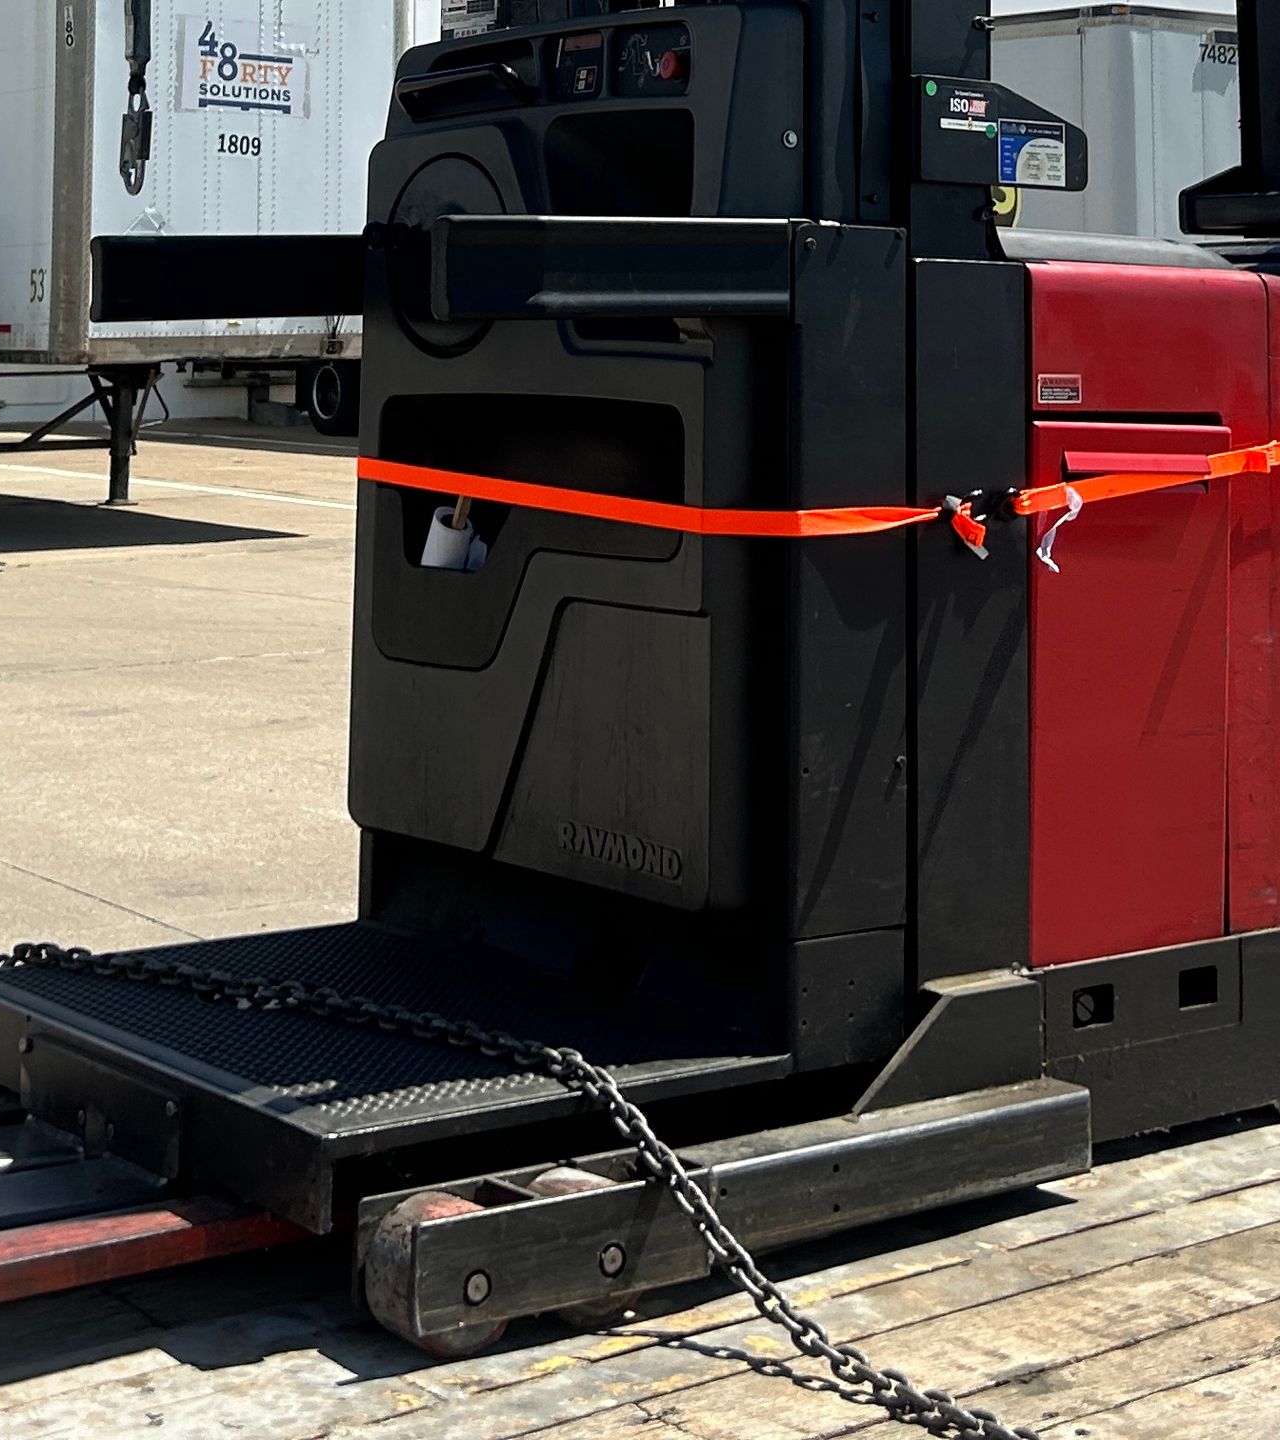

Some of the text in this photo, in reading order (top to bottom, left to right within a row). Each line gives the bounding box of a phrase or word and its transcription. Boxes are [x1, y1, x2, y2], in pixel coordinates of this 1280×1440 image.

[1199, 43, 1236, 65] 7482
[198, 83, 292, 102] SOLUTIONS
[217, 133, 261, 157] 1809
[558, 819, 684, 883] RAYMOND
